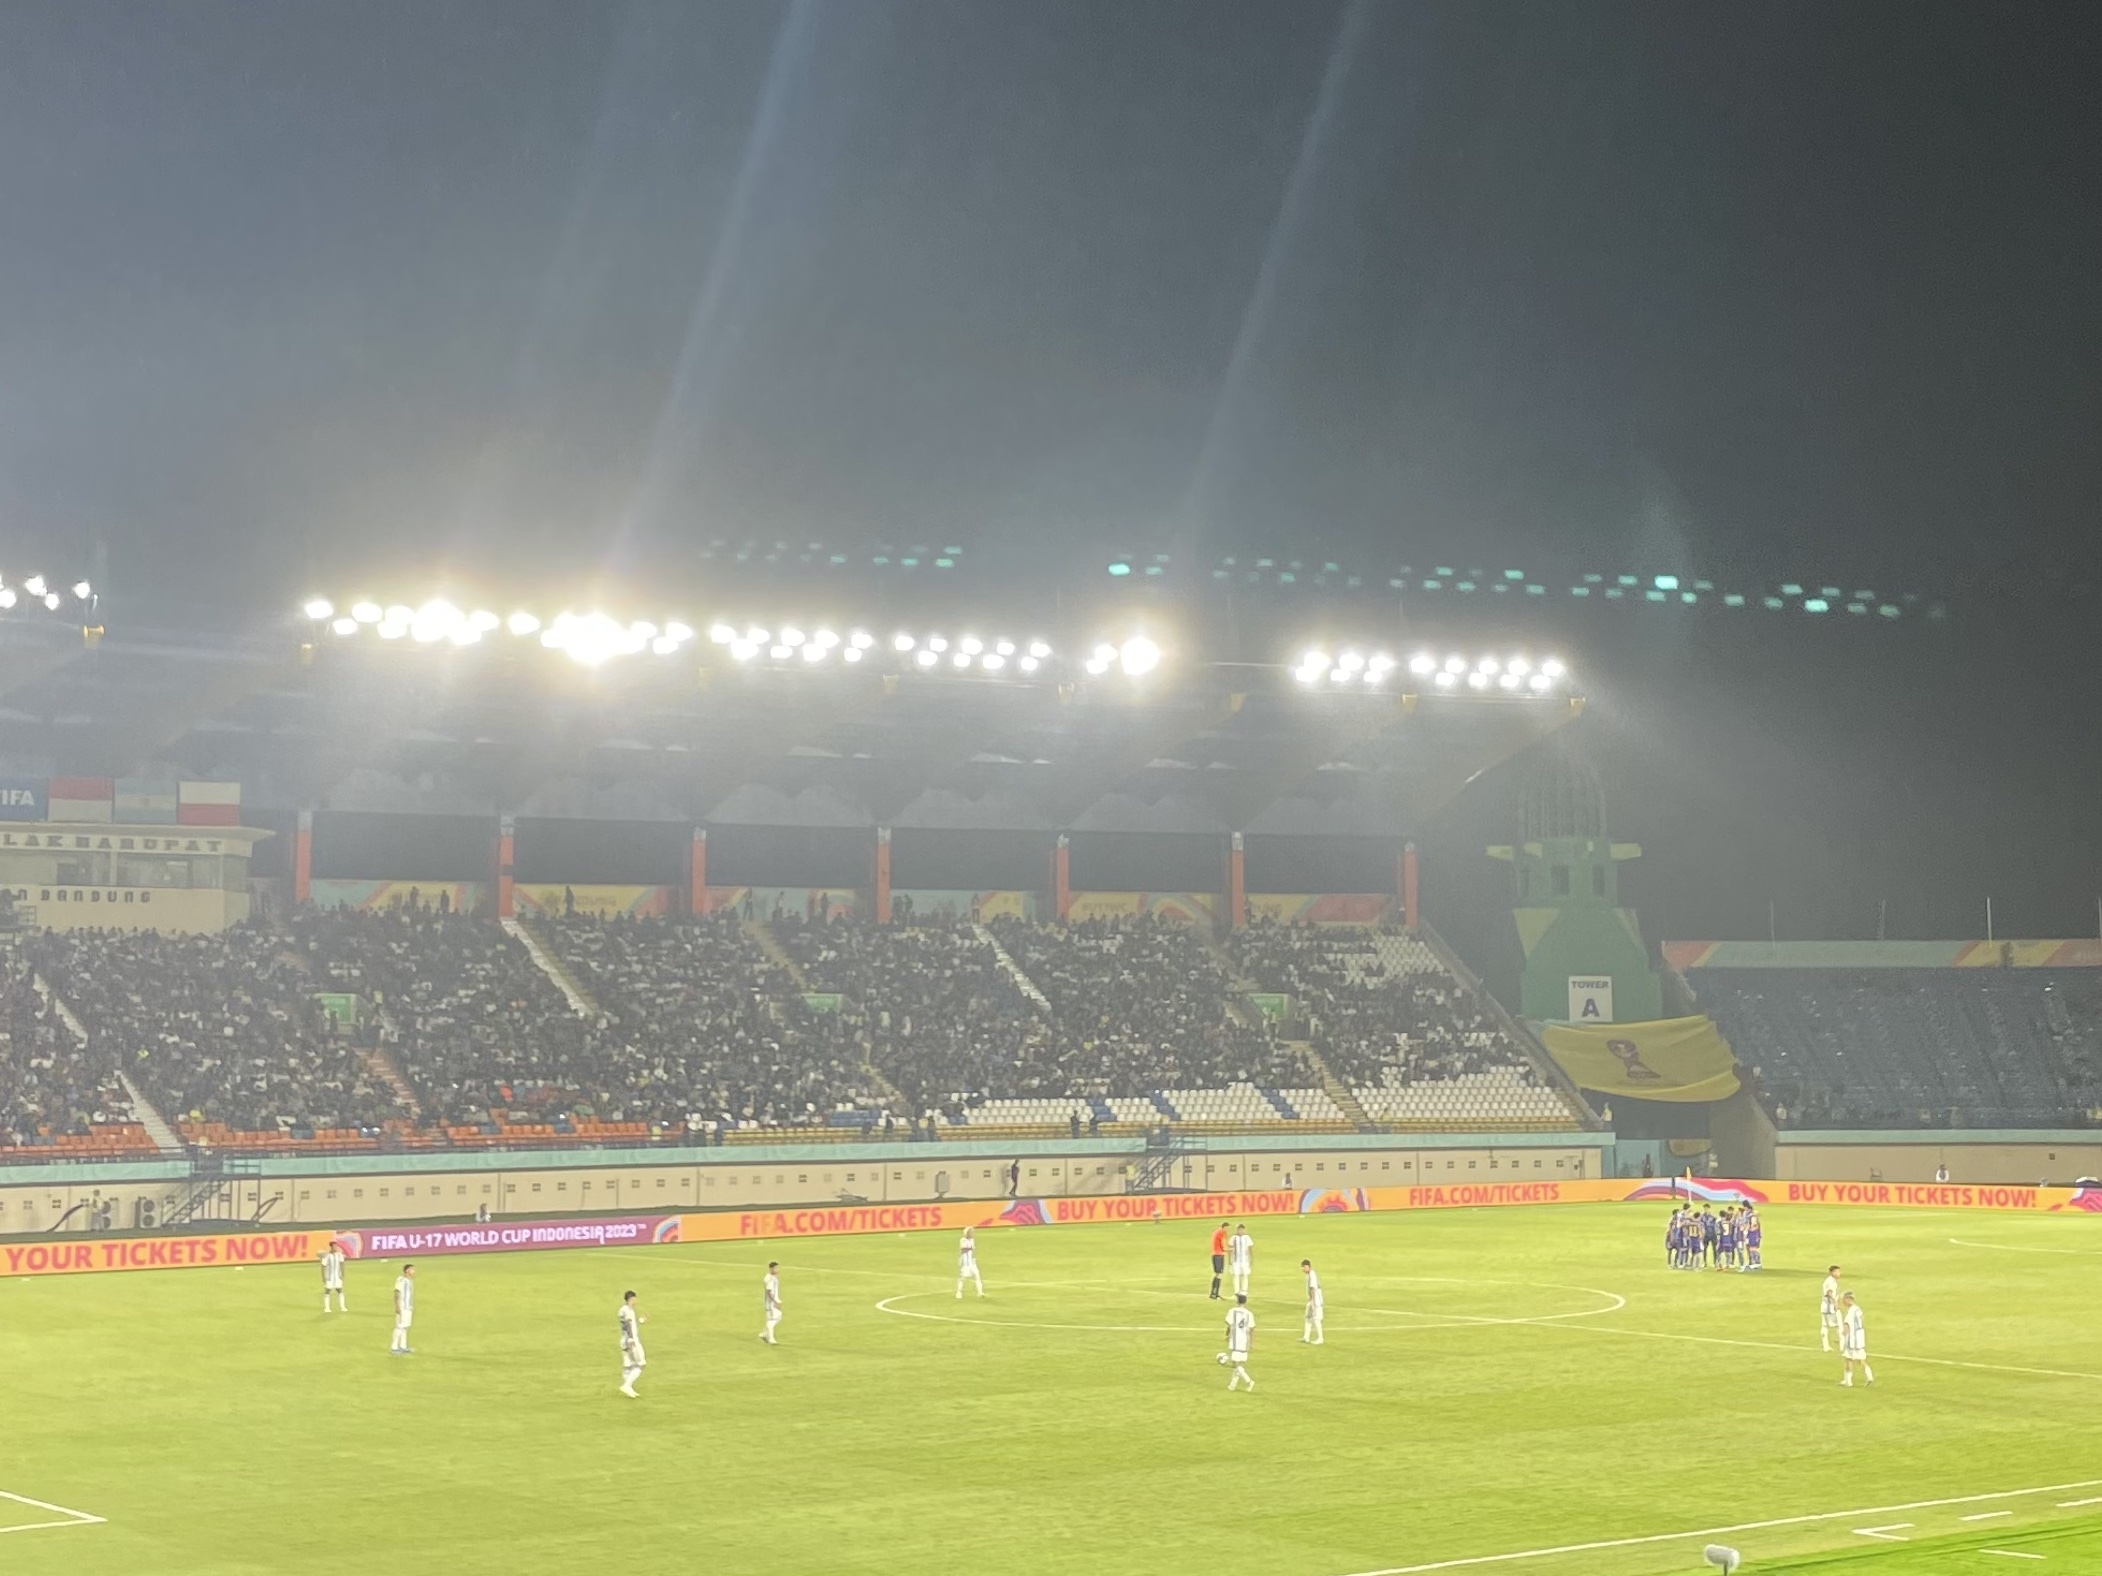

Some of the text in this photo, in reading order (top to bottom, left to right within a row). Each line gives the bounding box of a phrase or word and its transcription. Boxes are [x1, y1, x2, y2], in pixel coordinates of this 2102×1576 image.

[0, 789, 35, 805] IFA
[75, 836, 222, 852] HARUPAT
[40, 890, 151, 904] BANDUNG
[1571, 980, 1609, 989] TOWER
[1581, 998, 1600, 1018] A
[1409, 1183, 1559, 1206] FIFA.COM/TICKETS
[1788, 1183, 2036, 1208] BUY YOUR TICKETS NOW!
[1057, 1200, 1098, 1221] BUY
[1163, 1195, 1236, 1217] TICKETS
[1241, 1193, 1294, 1213] NOW!
[740, 1206, 942, 1235] FIFA.COM/TICKETS
[372, 1233, 407, 1250] FIFA
[409, 1231, 441, 1248] U-17
[445, 1230, 499, 1247] WORLD
[503, 1228, 530, 1244] CUP
[533, 1226, 605, 1244] INDONESIA
[5, 1235, 308, 1272] YOUR TICKETS NOW!
